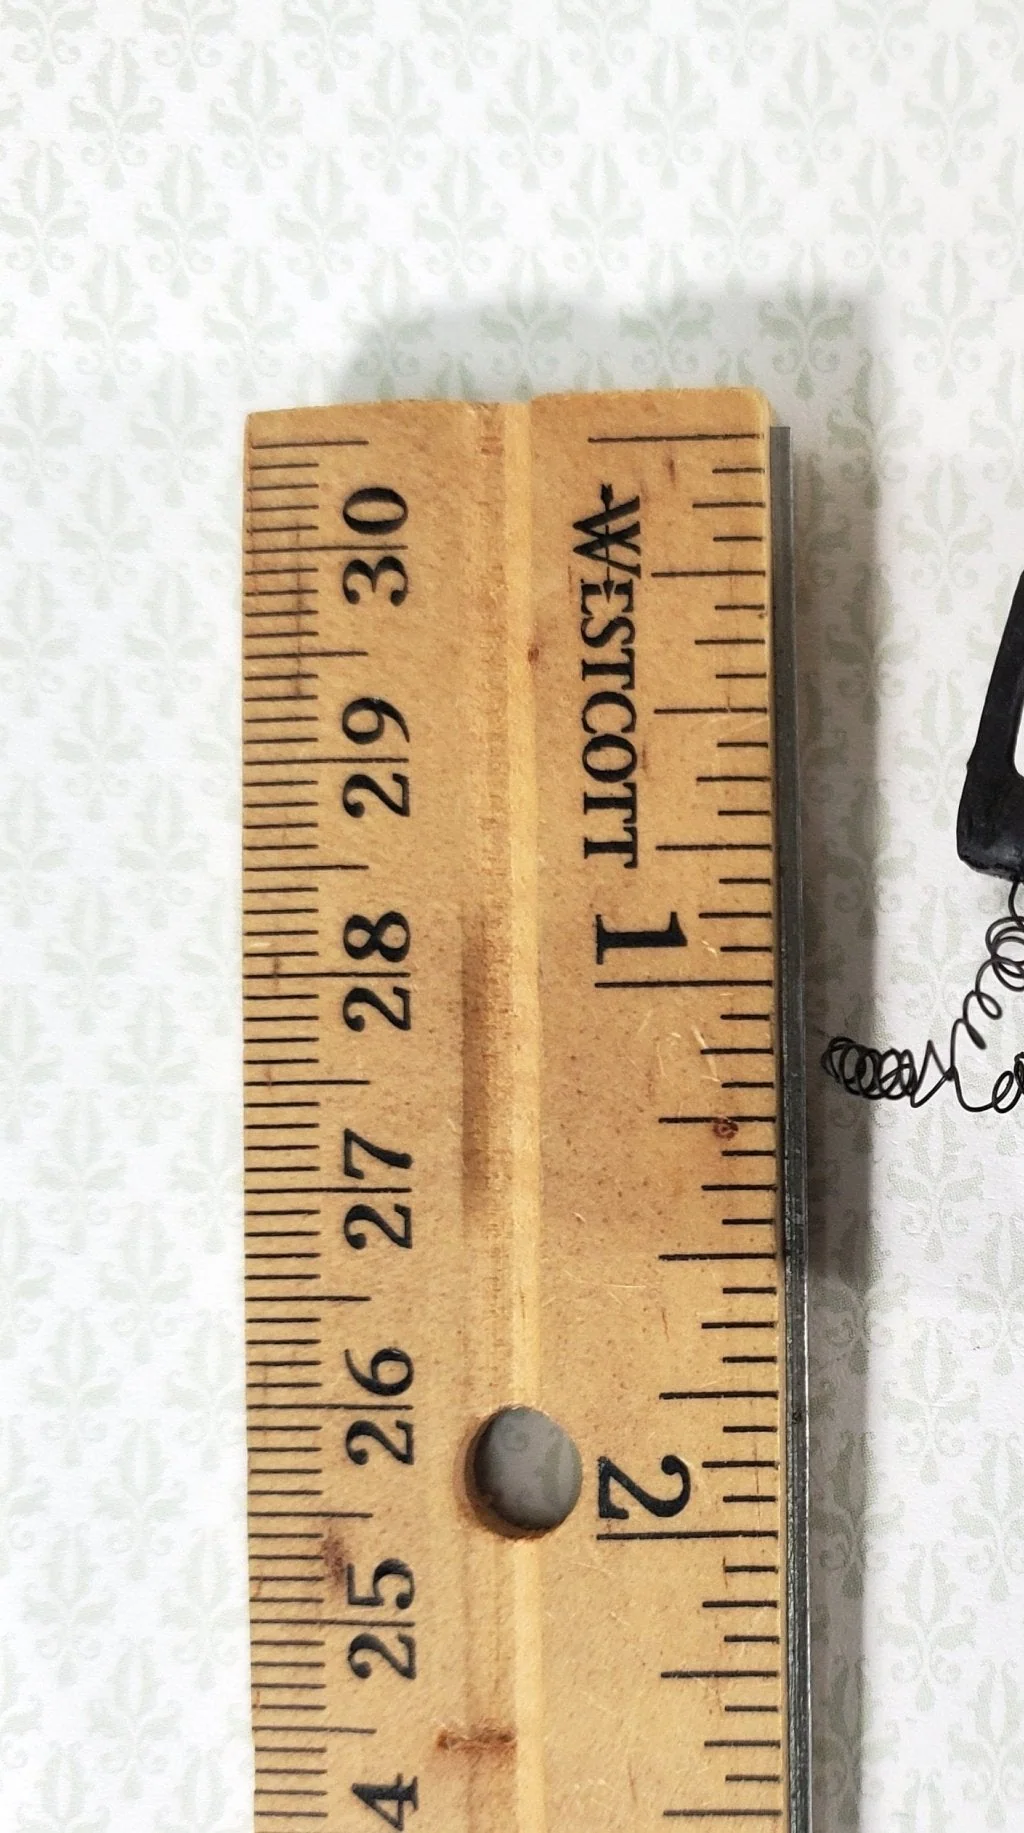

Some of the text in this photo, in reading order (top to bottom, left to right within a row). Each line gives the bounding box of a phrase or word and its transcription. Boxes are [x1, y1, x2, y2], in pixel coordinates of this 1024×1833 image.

[342, 486, 409, 606] 30
[572, 484, 642, 870] WESTCOTT
[341, 697, 410, 819] 29
[342, 910, 412, 1032] 28
[595, 911, 688, 966] 1
[343, 1128, 413, 1250] 27
[345, 1347, 414, 1466] 26
[598, 1454, 691, 1521] 2
[346, 1559, 415, 1680] 25
